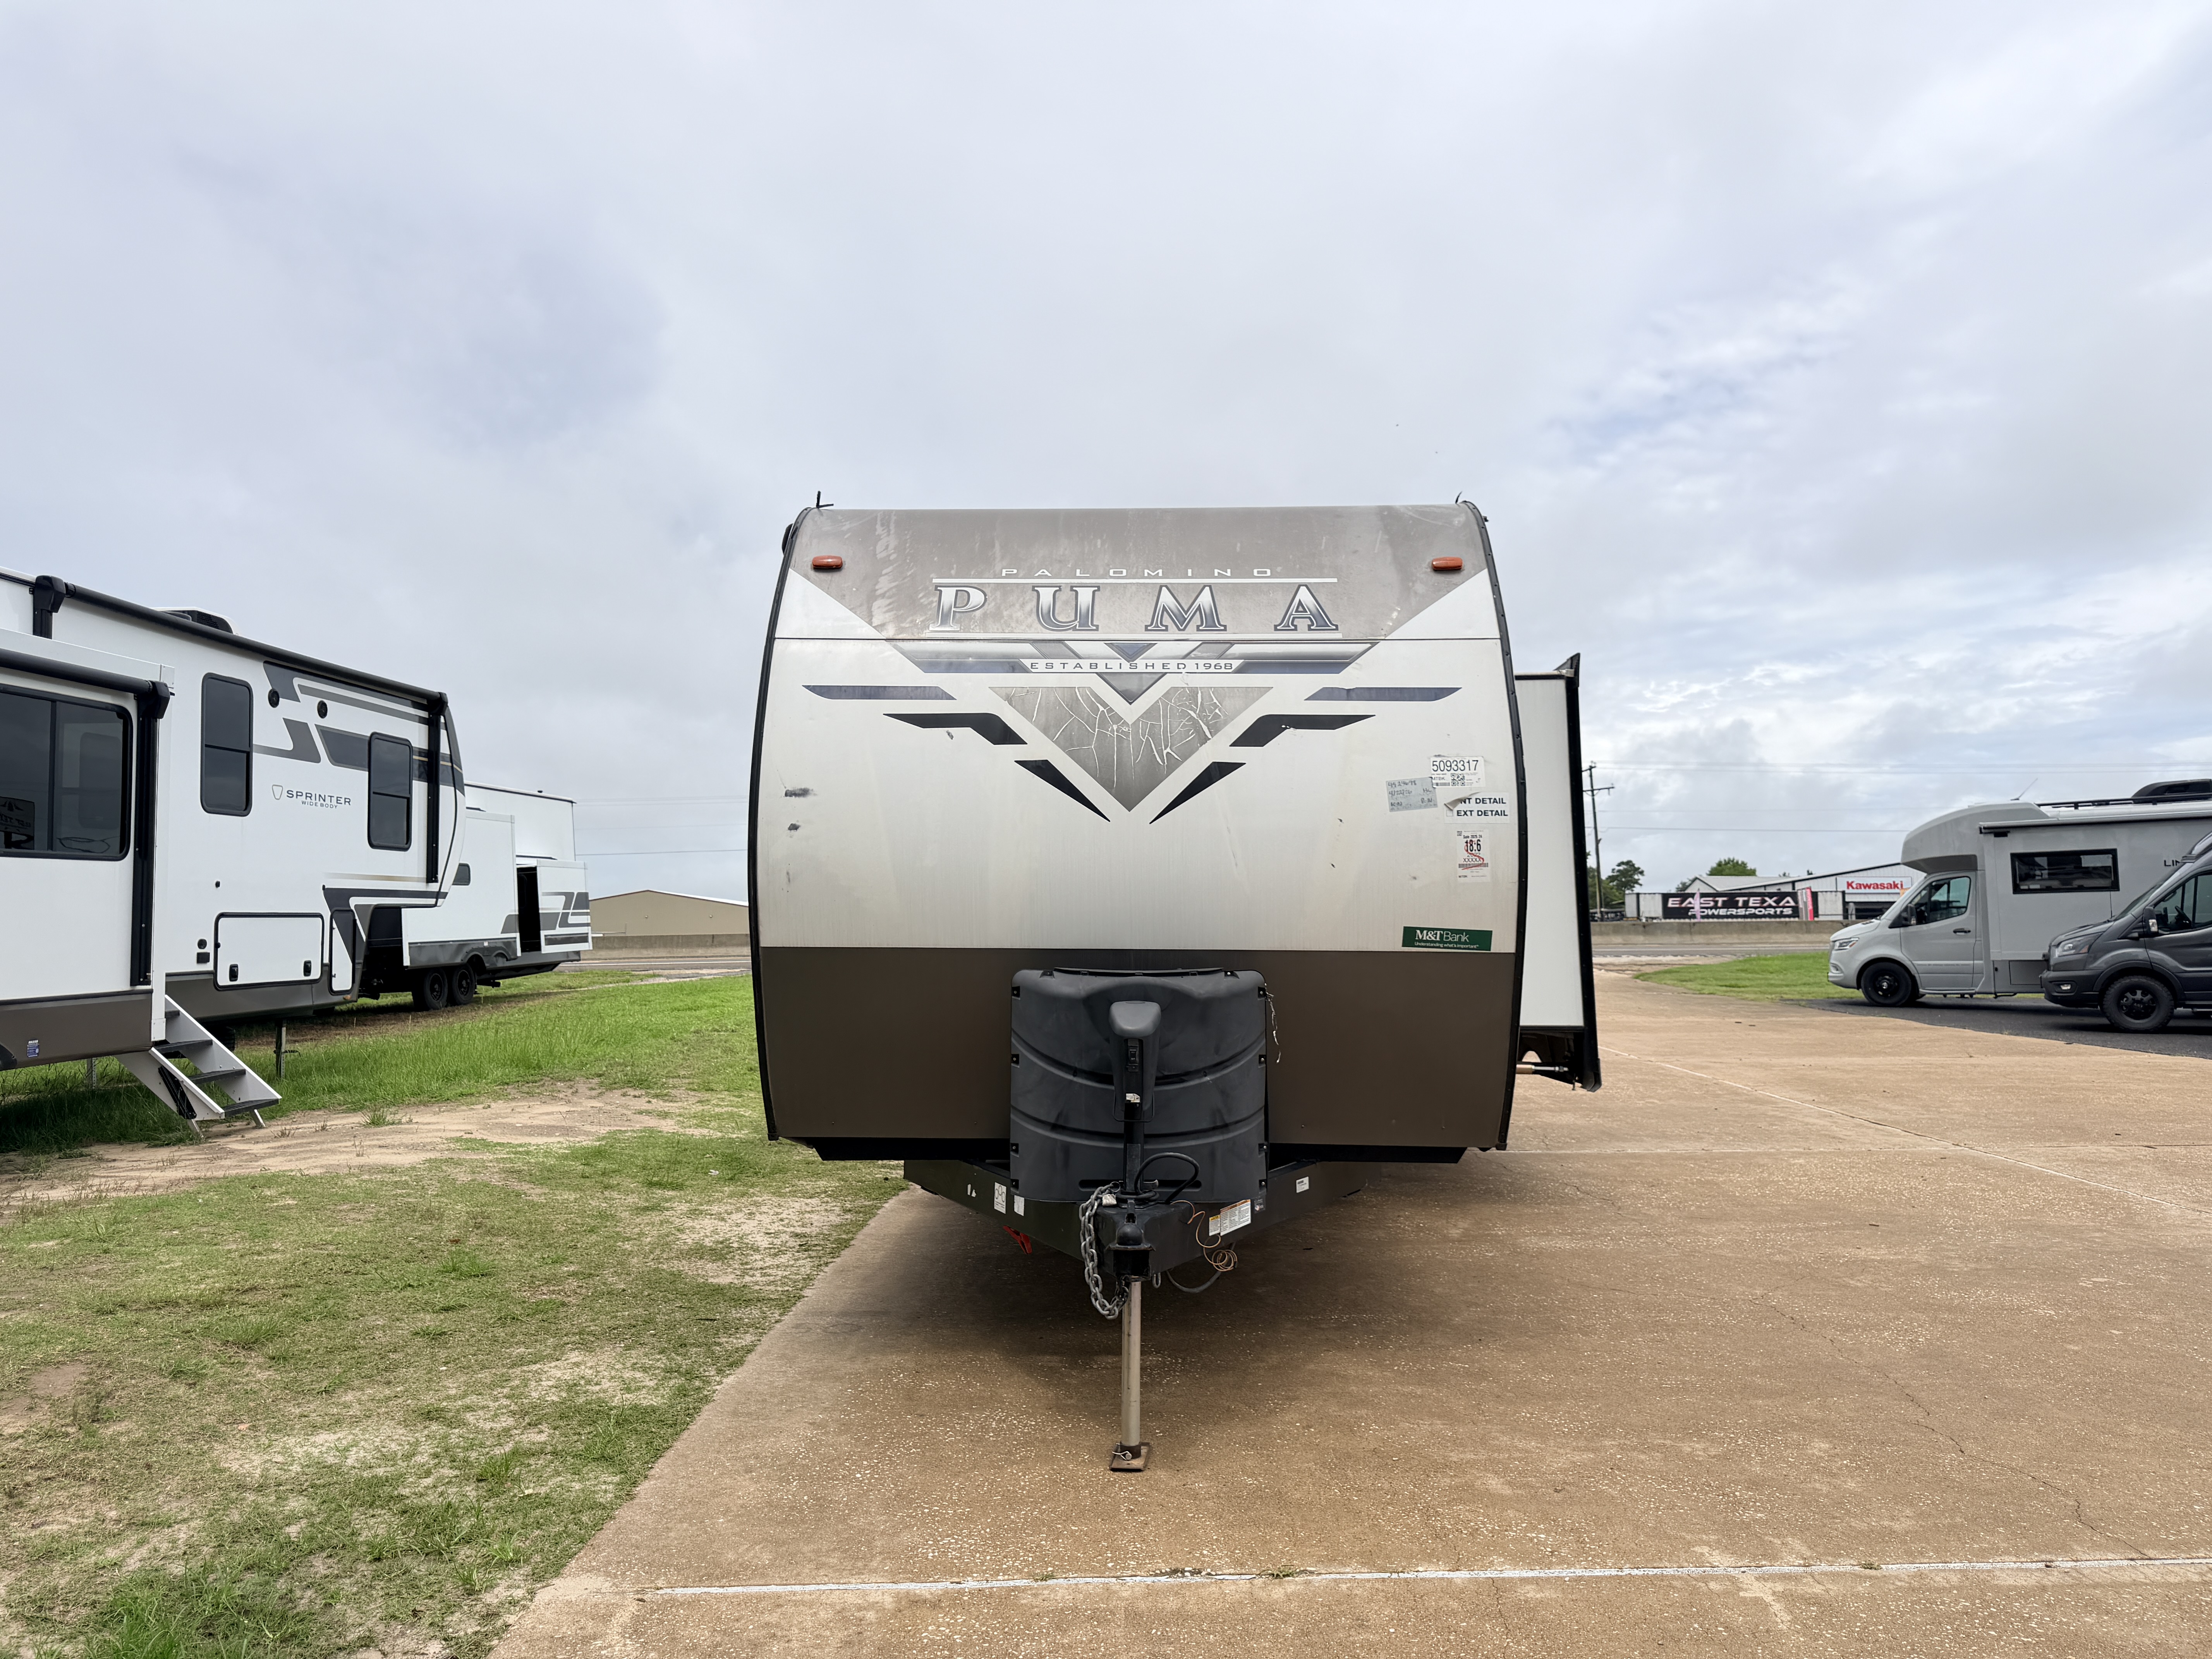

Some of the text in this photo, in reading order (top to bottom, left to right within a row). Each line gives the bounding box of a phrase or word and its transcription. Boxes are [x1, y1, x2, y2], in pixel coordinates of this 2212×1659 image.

[1001, 568, 1271, 577] PALOMINO
[928, 584, 1339, 632] PUMA
[1432, 759, 1479, 772] 5093317
[286, 790, 351, 805] SPRINTER
[1846, 881, 1904, 890] Kawasaki
[1668, 896, 1798, 907] EAST TEXA
[1415, 929, 1470, 942] M&T Bank
